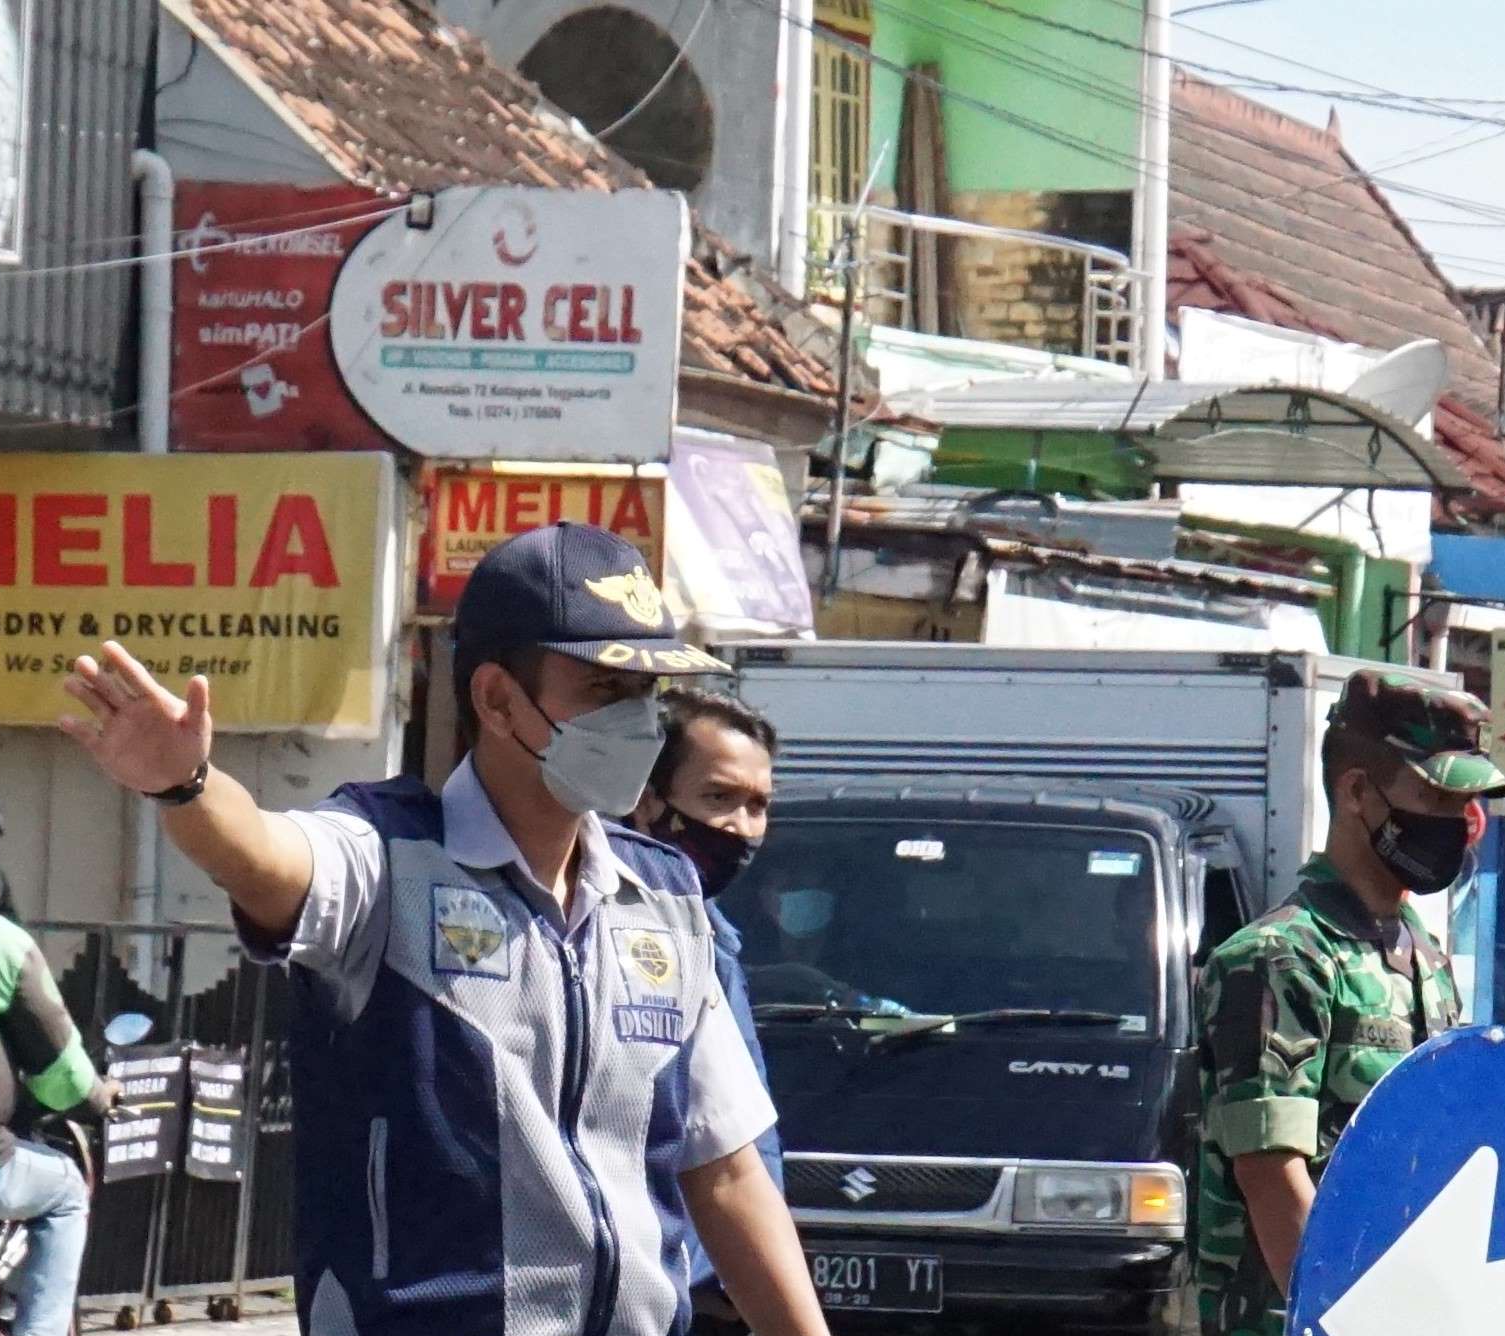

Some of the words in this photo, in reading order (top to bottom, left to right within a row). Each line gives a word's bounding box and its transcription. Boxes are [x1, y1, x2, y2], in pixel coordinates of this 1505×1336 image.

[380, 280, 528, 341] SILVER
[542, 284, 643, 343] CELL
[78, 612, 98, 637] &
[112, 611, 341, 639] DRYCLEANING
[5, 653, 43, 675] We
[178, 653, 251, 676] Better
[812, 1255, 877, 1291] 8201
[906, 1257, 939, 1293] YT
